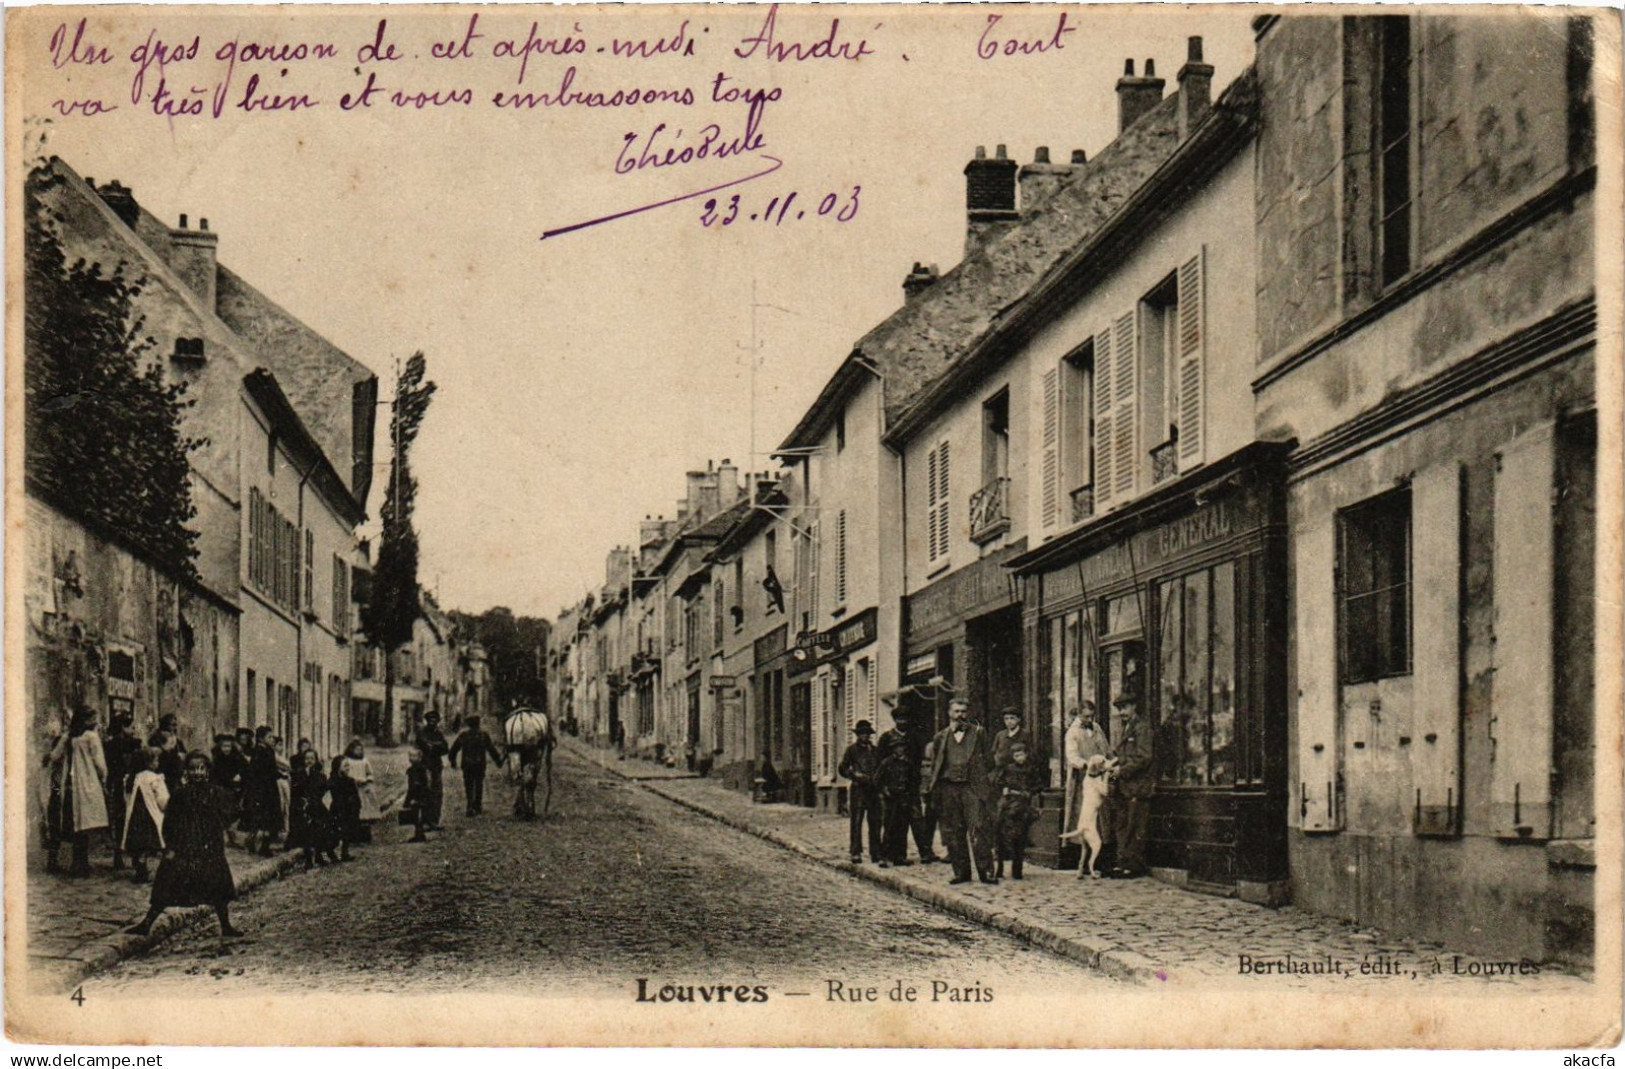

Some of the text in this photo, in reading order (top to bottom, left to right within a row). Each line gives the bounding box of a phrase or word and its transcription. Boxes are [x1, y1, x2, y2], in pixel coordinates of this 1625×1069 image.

[50, 18, 114, 66] Un
[130, 28, 200, 108] gros
[357, 19, 405, 64] de
[431, 14, 483, 60] cet
[52, 97, 118, 116] va
[147, 78, 205, 118] très
[236, 68, 321, 112] bien
[338, 85, 388, 112] et
[390, 89, 472, 108] vous
[491, 66, 695, 110] embrassons
